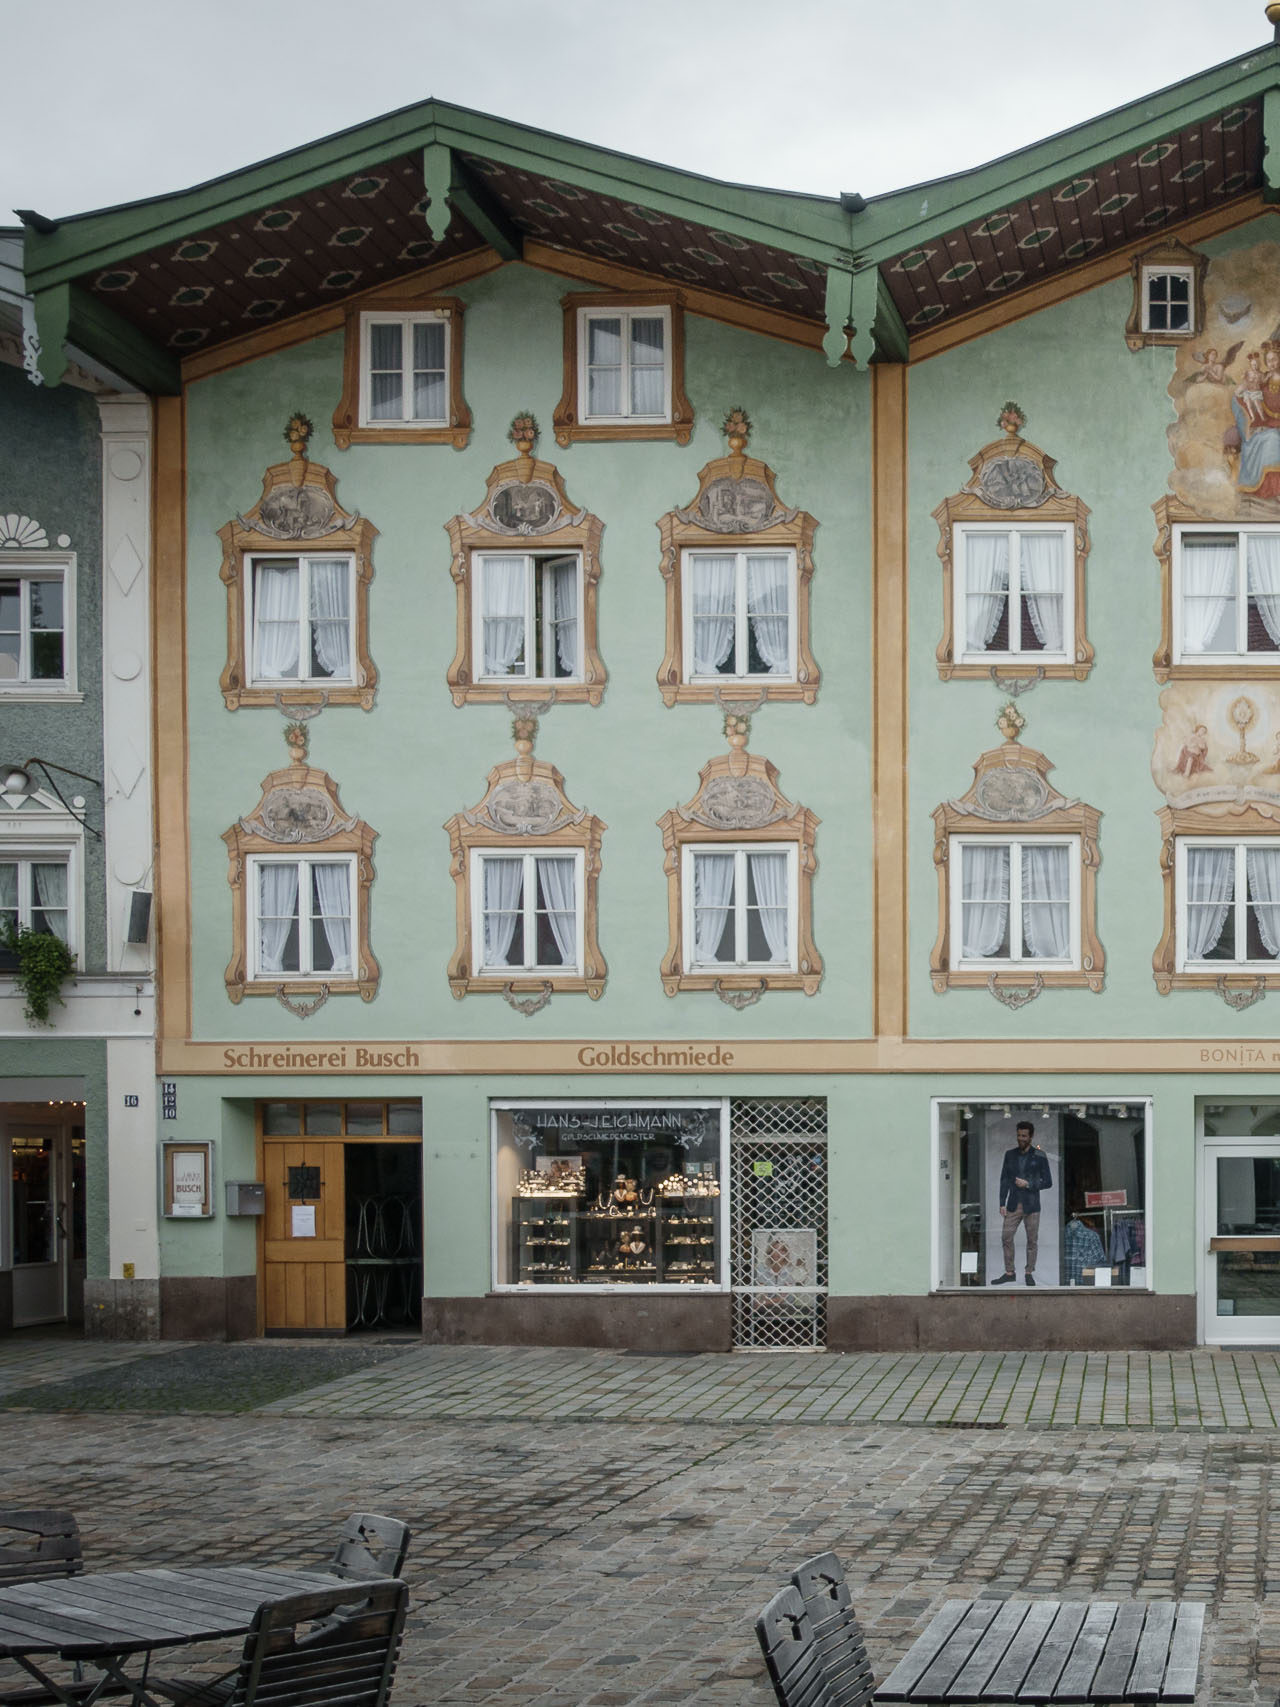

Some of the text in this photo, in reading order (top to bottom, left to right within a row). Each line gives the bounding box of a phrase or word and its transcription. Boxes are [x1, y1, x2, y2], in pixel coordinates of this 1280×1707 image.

[223, 1046, 420, 1068] Schreinerei Busch
[577, 1045, 734, 1067] Goldschmiede
[1200, 1045, 1266, 1066] BONITA
[164, 1083, 175, 1094] 14
[126, 1096, 138, 1106] 16
[164, 1095, 175, 1106] 12
[164, 1108, 175, 1118] 10
[176, 1184, 201, 1193] BUSCH
